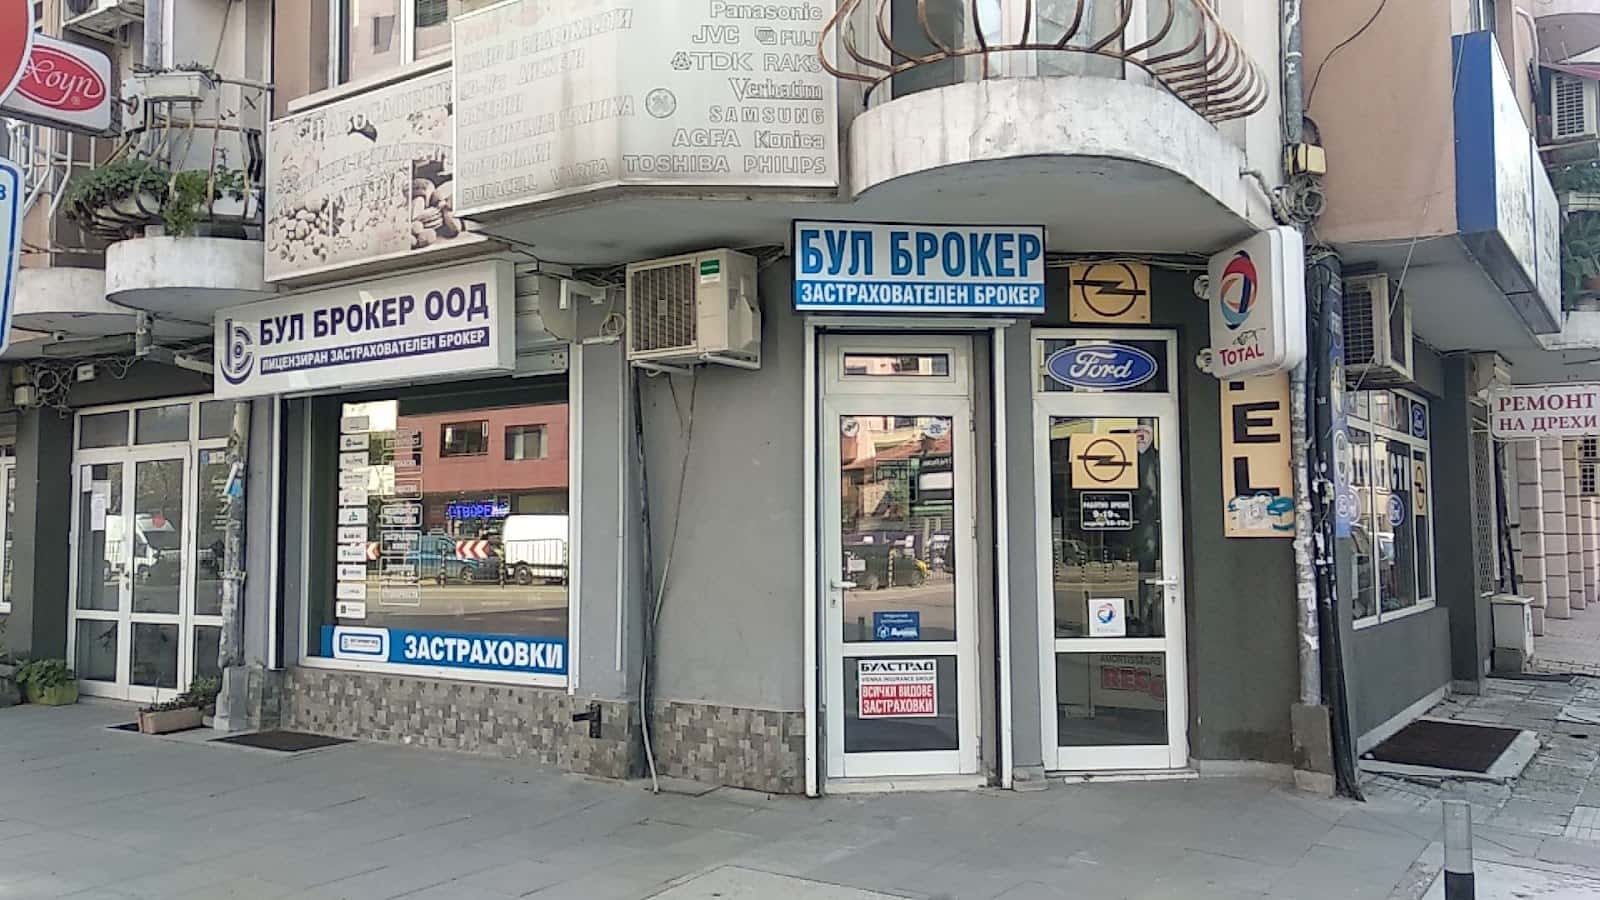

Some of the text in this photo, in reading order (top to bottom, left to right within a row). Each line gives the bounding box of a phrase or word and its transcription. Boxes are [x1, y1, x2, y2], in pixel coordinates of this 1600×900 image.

[710, 0, 823, 20] Panasonic
[692, 25, 739, 44] JVC
[690, 52, 823, 73] TDK RAKS
[728, 77, 824, 101] Verbatim
[709, 105, 825, 125] SAMSUNG
[672, 128, 824, 149] AGFA Konica
[622, 154, 730, 173] TOSHIBA
[744, 155, 826, 174] PHILIPS
[801, 229, 1041, 278] БУЛ БРОКЕР
[801, 286, 1040, 306] ЗАСТРАХОВАТЕЛЕН БРОКЕР
[259, 283, 489, 346] БУЛ БРОКЕР ООД
[261, 330, 486, 373] ЛИЦЕНЗИРАН ЗАСТРАХОВАТЕЛЕН БРОКЕР
[1219, 344, 1264, 366] TOTAL
[1070, 350, 1133, 379] Ford
[1499, 393, 1597, 412] РЕМОНТ
[1499, 415, 1597, 433] НА ДРЕХИ
[404, 635, 563, 669] ЗАСТРАХОВКИ
[860, 661, 934, 672] БУЛСТРАД
[862, 683, 933, 699] ВСИЧКИ ВИДОВЕ
[862, 698, 933, 714] ЗАСТРАХОВКИ
